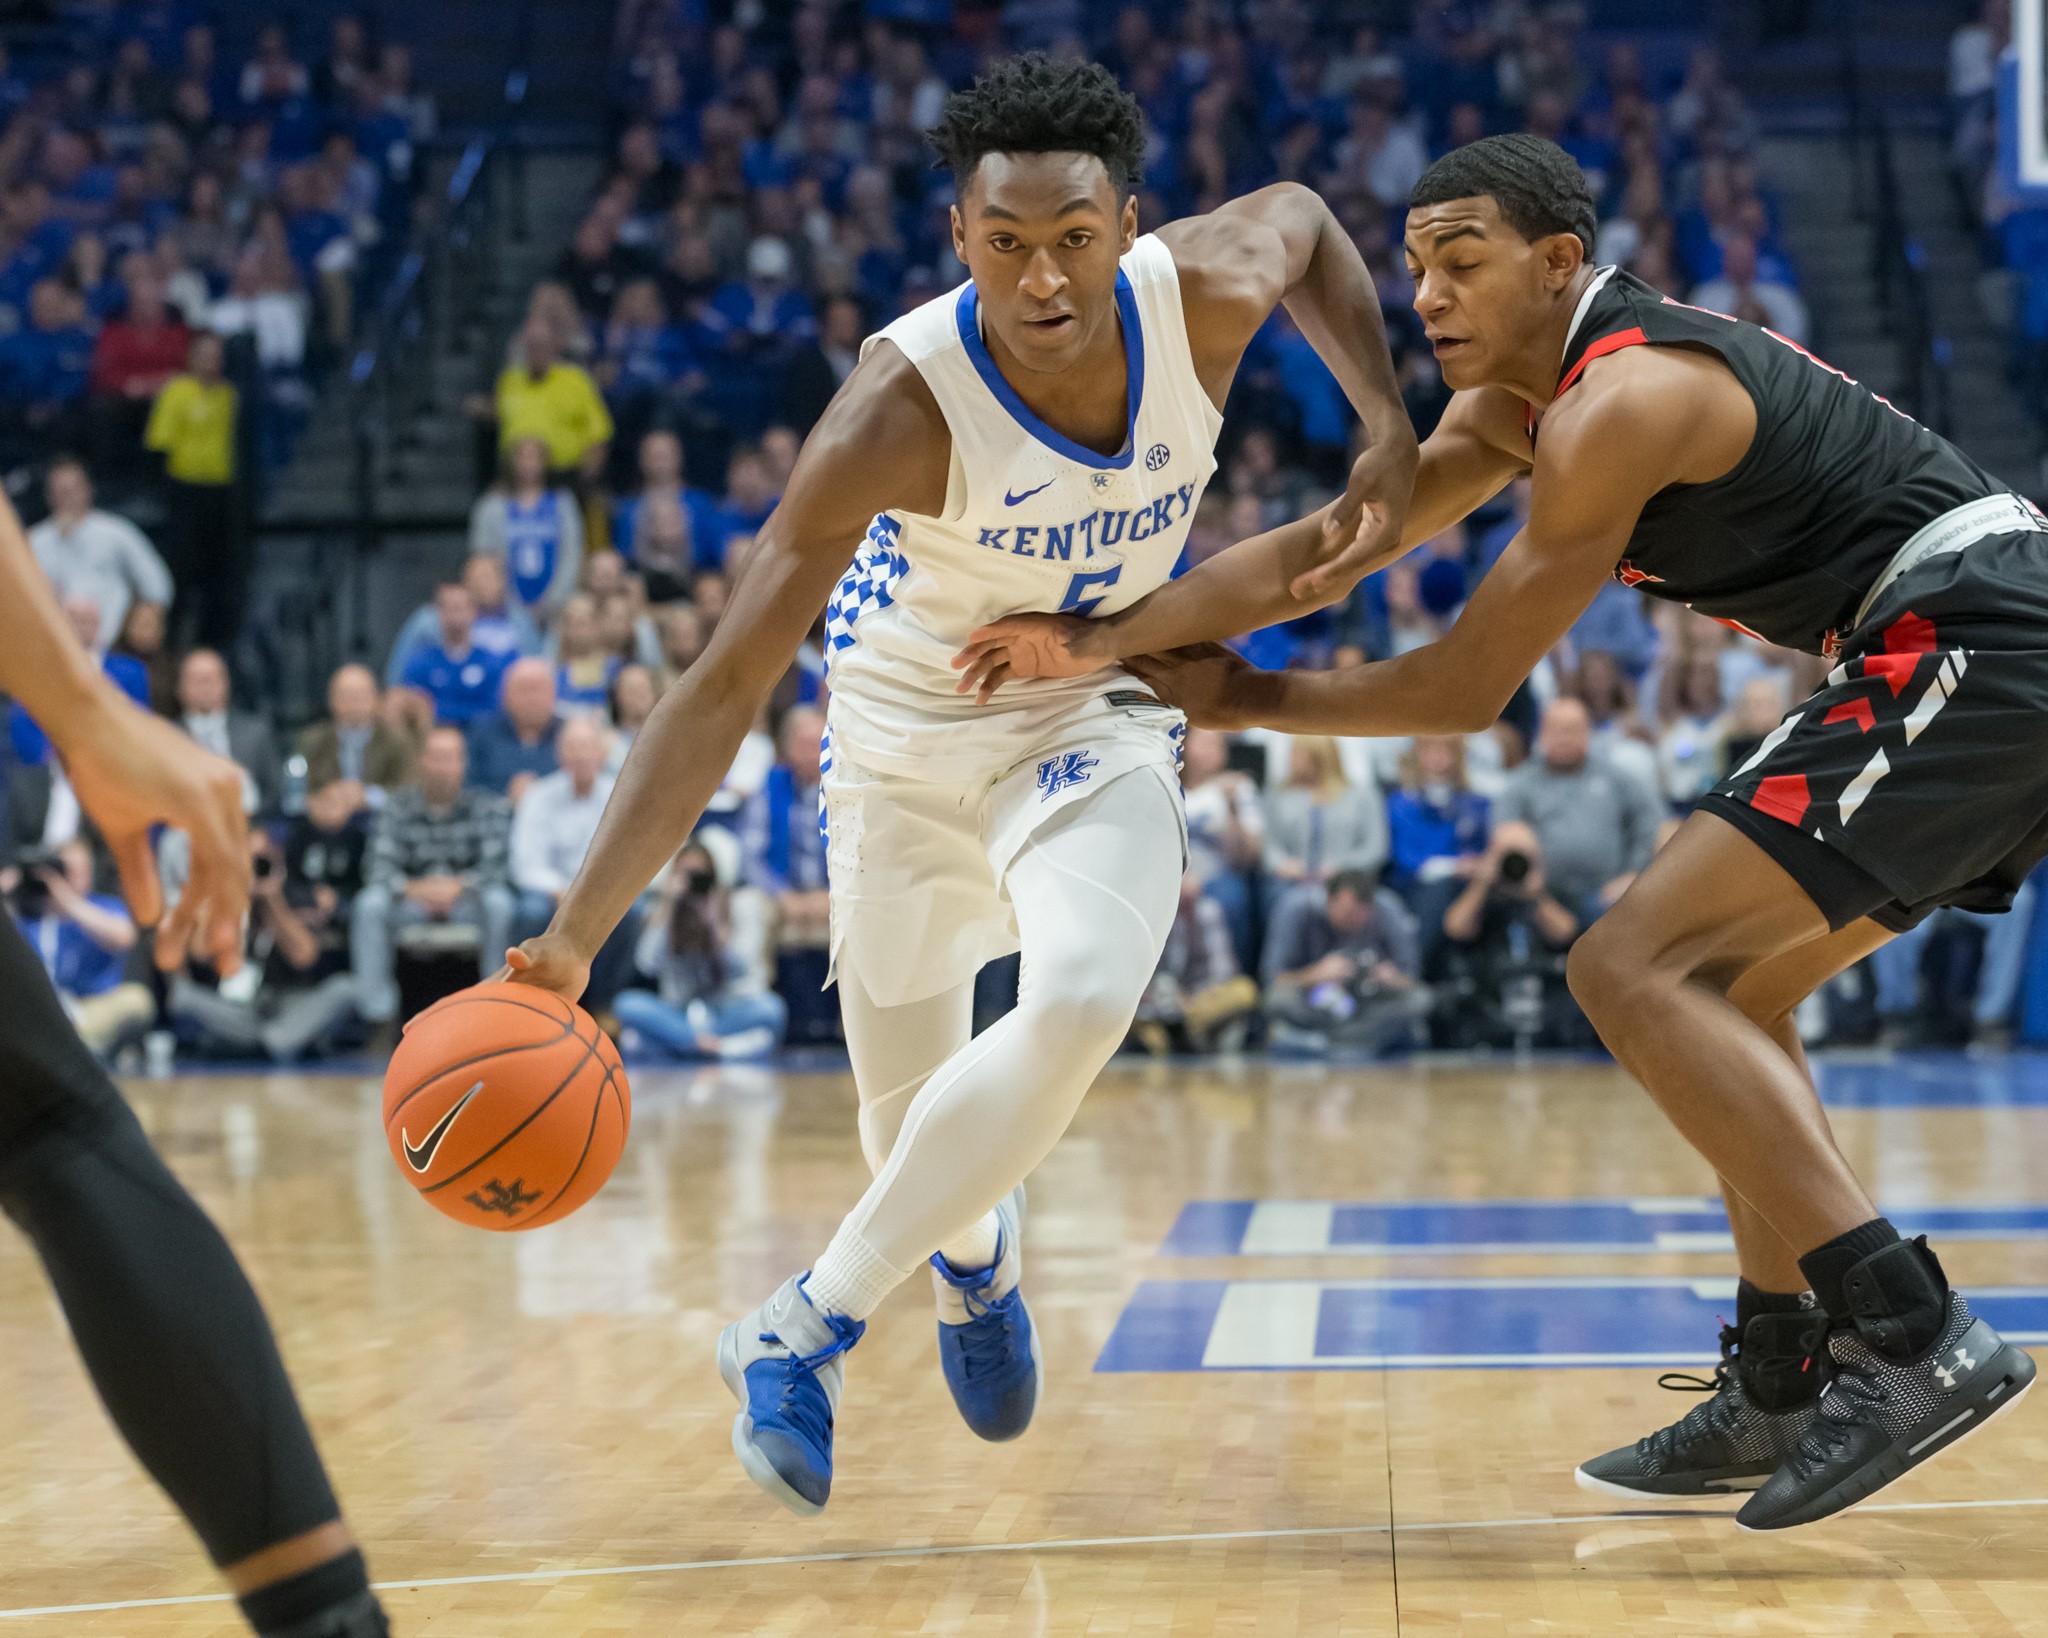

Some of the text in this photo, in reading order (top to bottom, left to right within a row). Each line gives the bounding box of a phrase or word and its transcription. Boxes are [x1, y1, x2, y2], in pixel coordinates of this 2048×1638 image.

[1146, 444, 1170, 470] SEC
[977, 482, 1195, 561] KENTUCKY
[1971, 508, 2014, 527] UNDER
[1037, 750, 1100, 803] UK
[464, 1177, 543, 1217] UK
